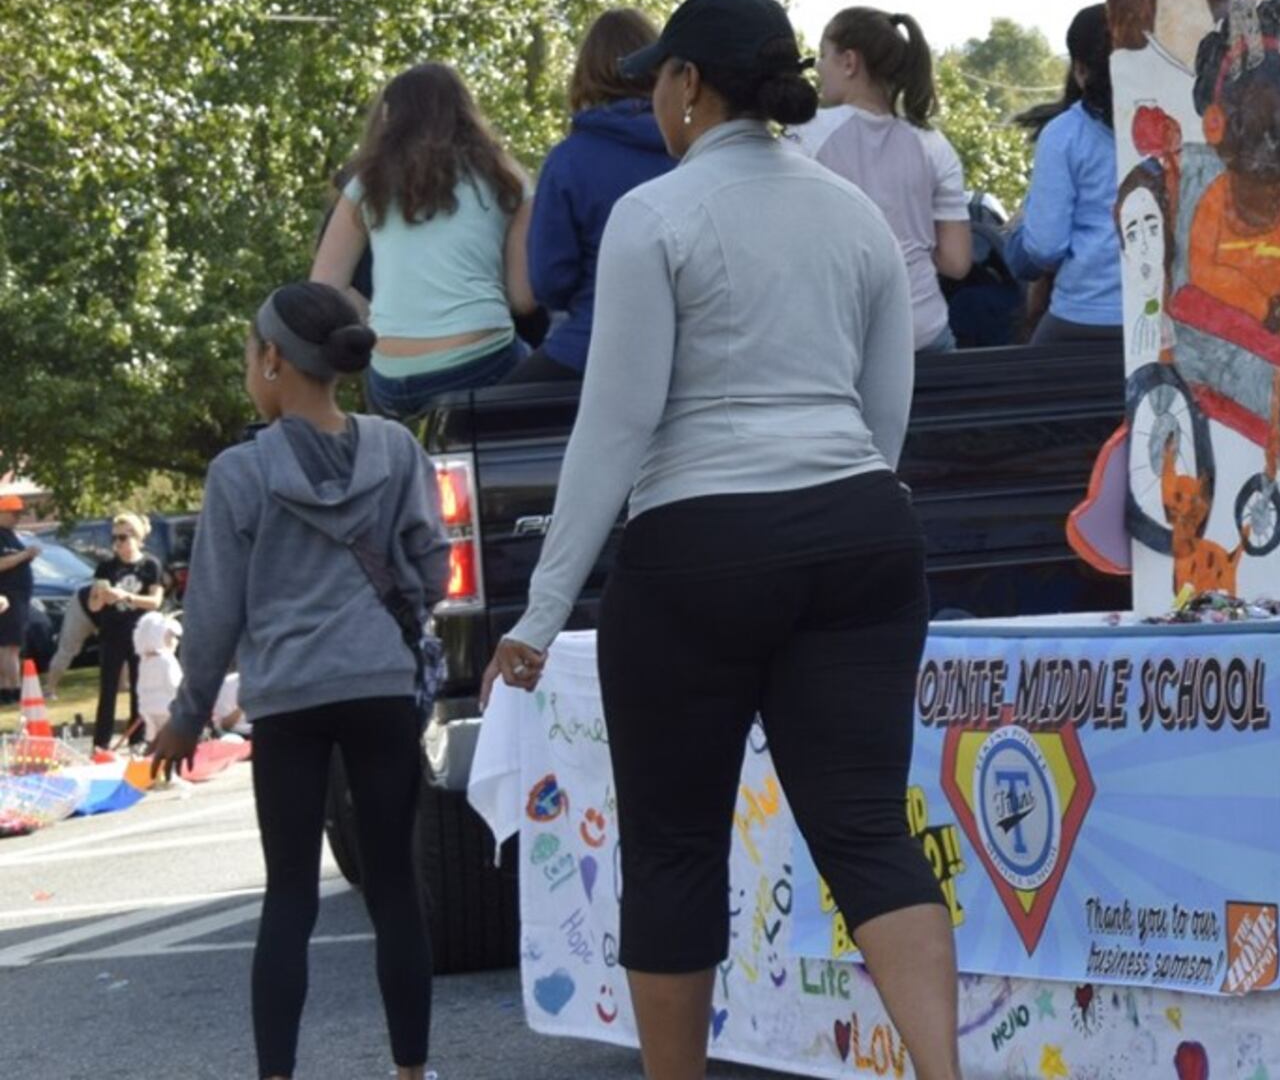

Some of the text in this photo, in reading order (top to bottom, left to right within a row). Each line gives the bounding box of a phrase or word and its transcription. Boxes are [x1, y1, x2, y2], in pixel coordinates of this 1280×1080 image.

[917, 659, 1009, 726] OINTE
[1016, 658, 1133, 729] MIDDLE
[1139, 657, 1271, 731] SCHOOL
[1086, 896, 1133, 934] Thank
[1137, 906, 1168, 944] you
[1172, 903, 1190, 938] to
[1087, 941, 1150, 978] business
[852, 1011, 907, 1077] LOV
